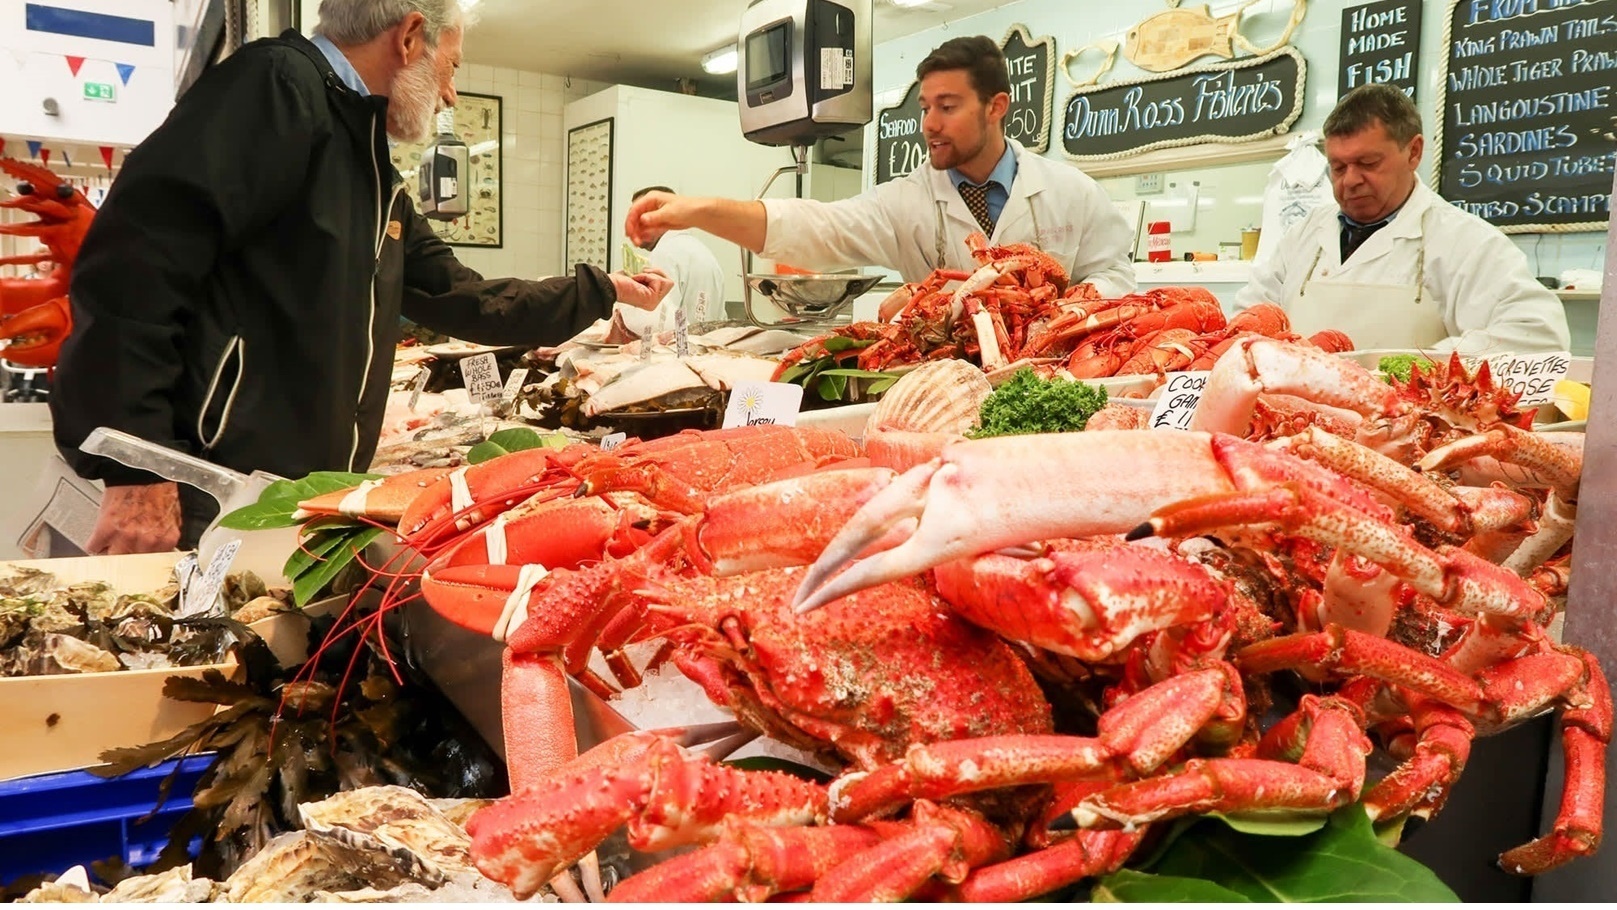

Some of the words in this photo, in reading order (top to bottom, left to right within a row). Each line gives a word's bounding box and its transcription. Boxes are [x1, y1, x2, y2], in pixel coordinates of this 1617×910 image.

[1351, 6, 1407, 32] HOME
[1348, 30, 1408, 56] MADE
[1454, 36, 1496, 58] KING
[1500, 25, 1558, 50] PRAWN
[1561, 15, 1617, 40] TAILS
[1347, 52, 1413, 88] FISH
[1449, 64, 1508, 92] WHOLE
[1510, 58, 1563, 82] TIGER
[1572, 49, 1617, 74] PRAW
[1066, 96, 1120, 139] Dunn
[1119, 86, 1185, 132] Ross
[1192, 69, 1284, 122] Fisheries
[1454, 86, 1611, 127] LANGOUSTINE
[880, 113, 918, 139] SEAFOOD
[1455, 125, 1578, 158] SARDINES
[1458, 161, 1548, 188] SQUID
[1522, 192, 1612, 216] SCAMPI
[1497, 355, 1569, 376] CREVETTES
[1168, 375, 1207, 392] COOK
